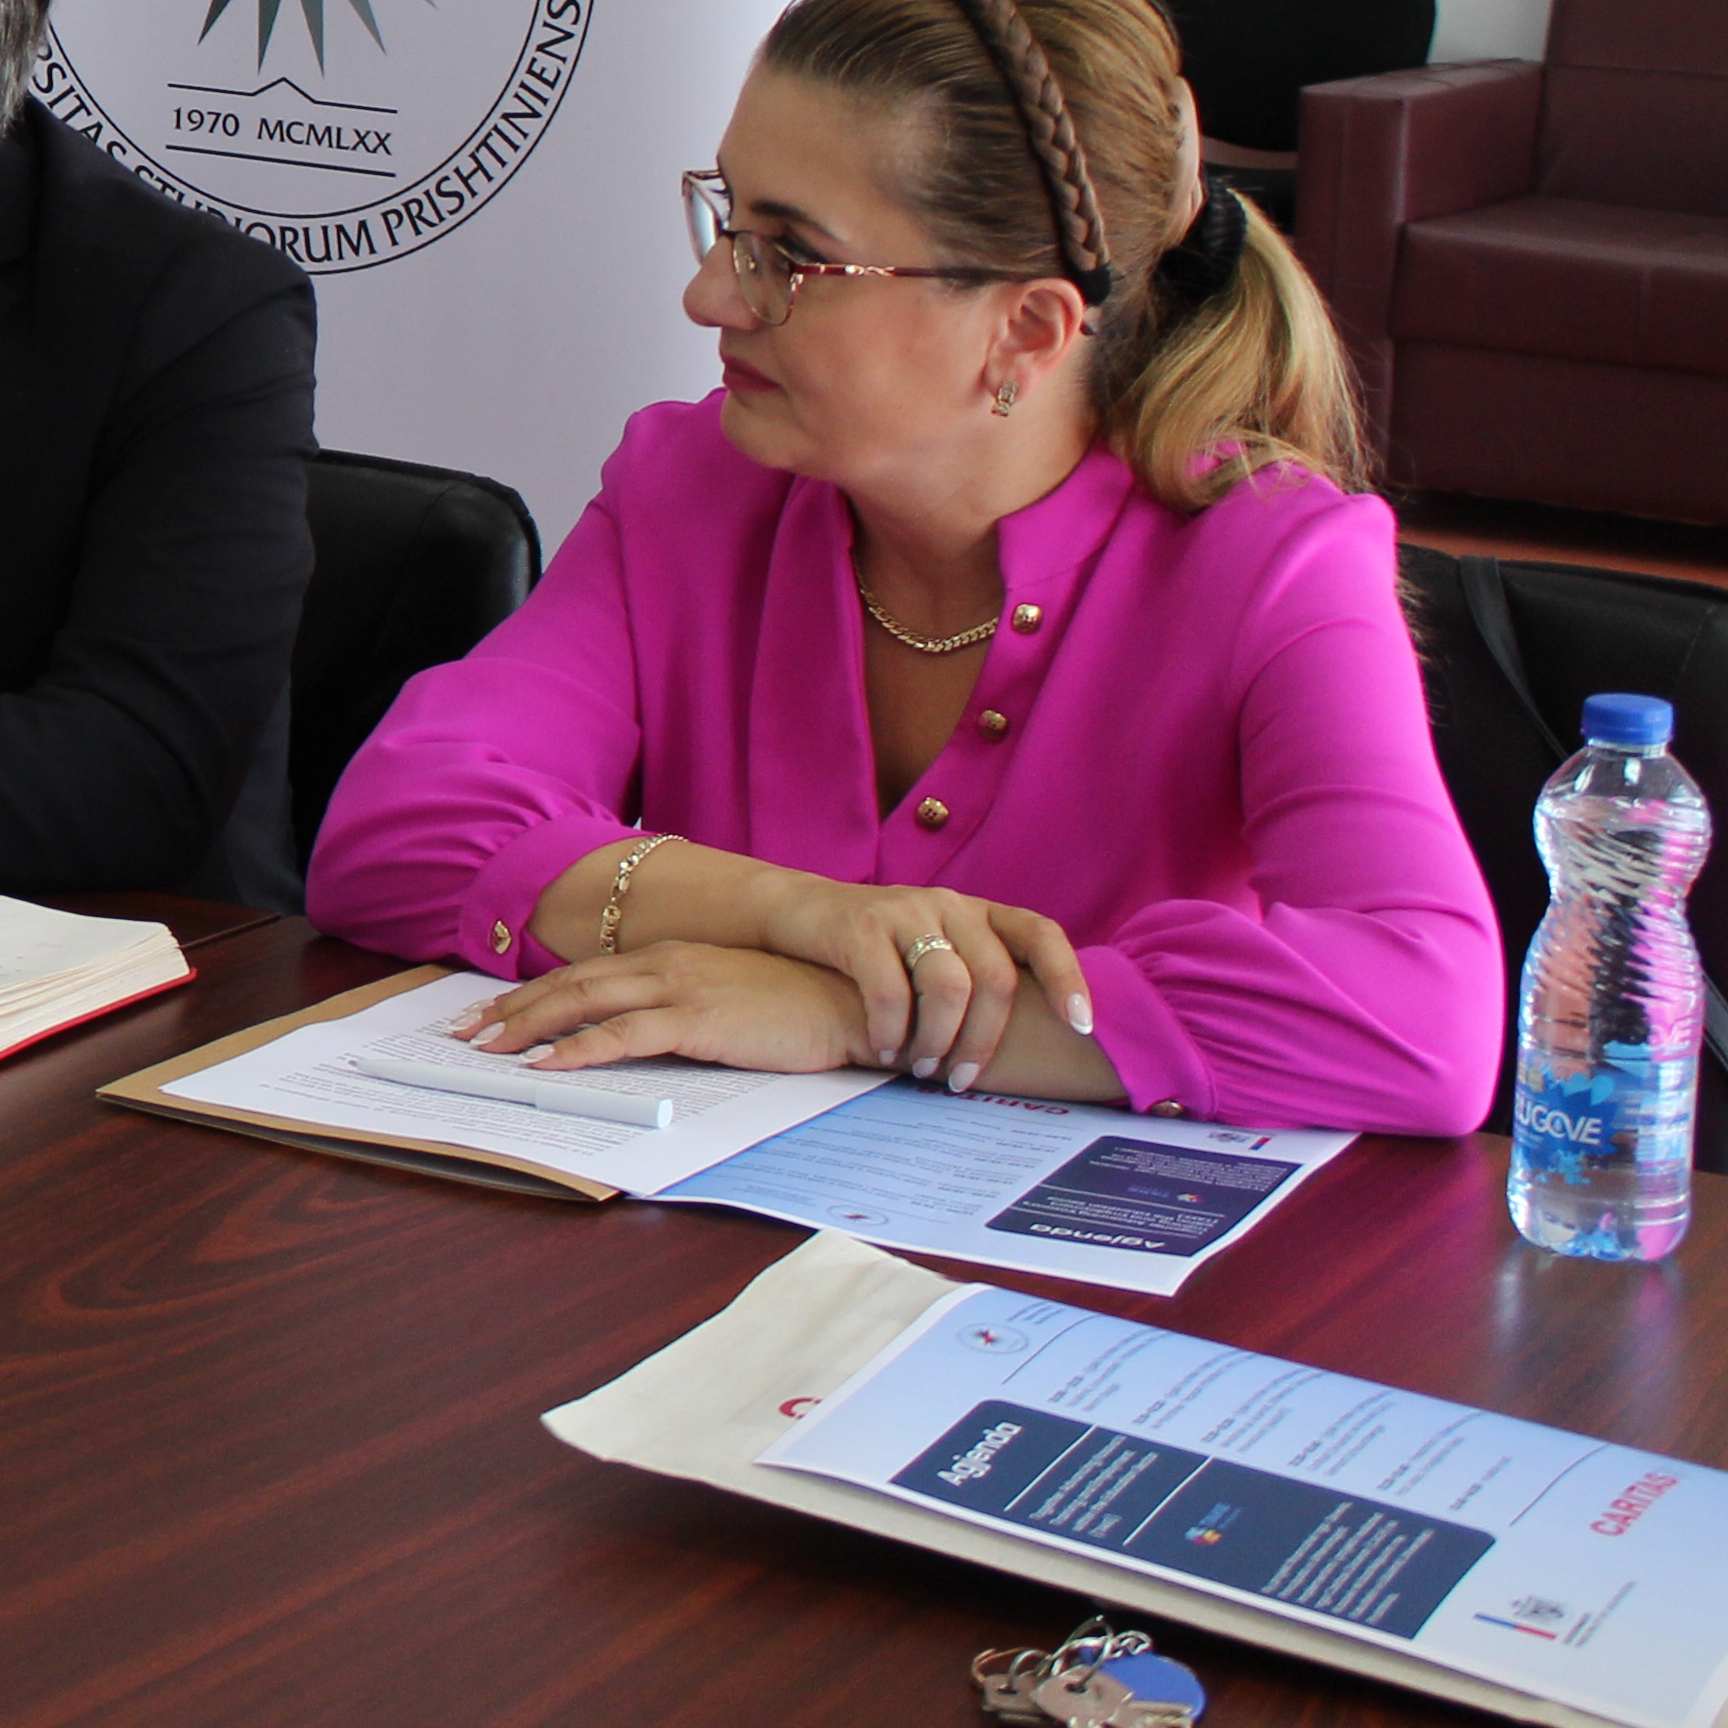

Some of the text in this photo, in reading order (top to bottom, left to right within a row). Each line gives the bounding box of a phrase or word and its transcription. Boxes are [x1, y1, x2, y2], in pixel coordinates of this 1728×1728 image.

[170, 105, 394, 157] 1970 MCMLXX
[1028, 1222, 1166, 1250] Agjenda
[936, 1421, 1023, 1487] Agjenda
[1589, 1472, 1680, 1537] CARITAS
